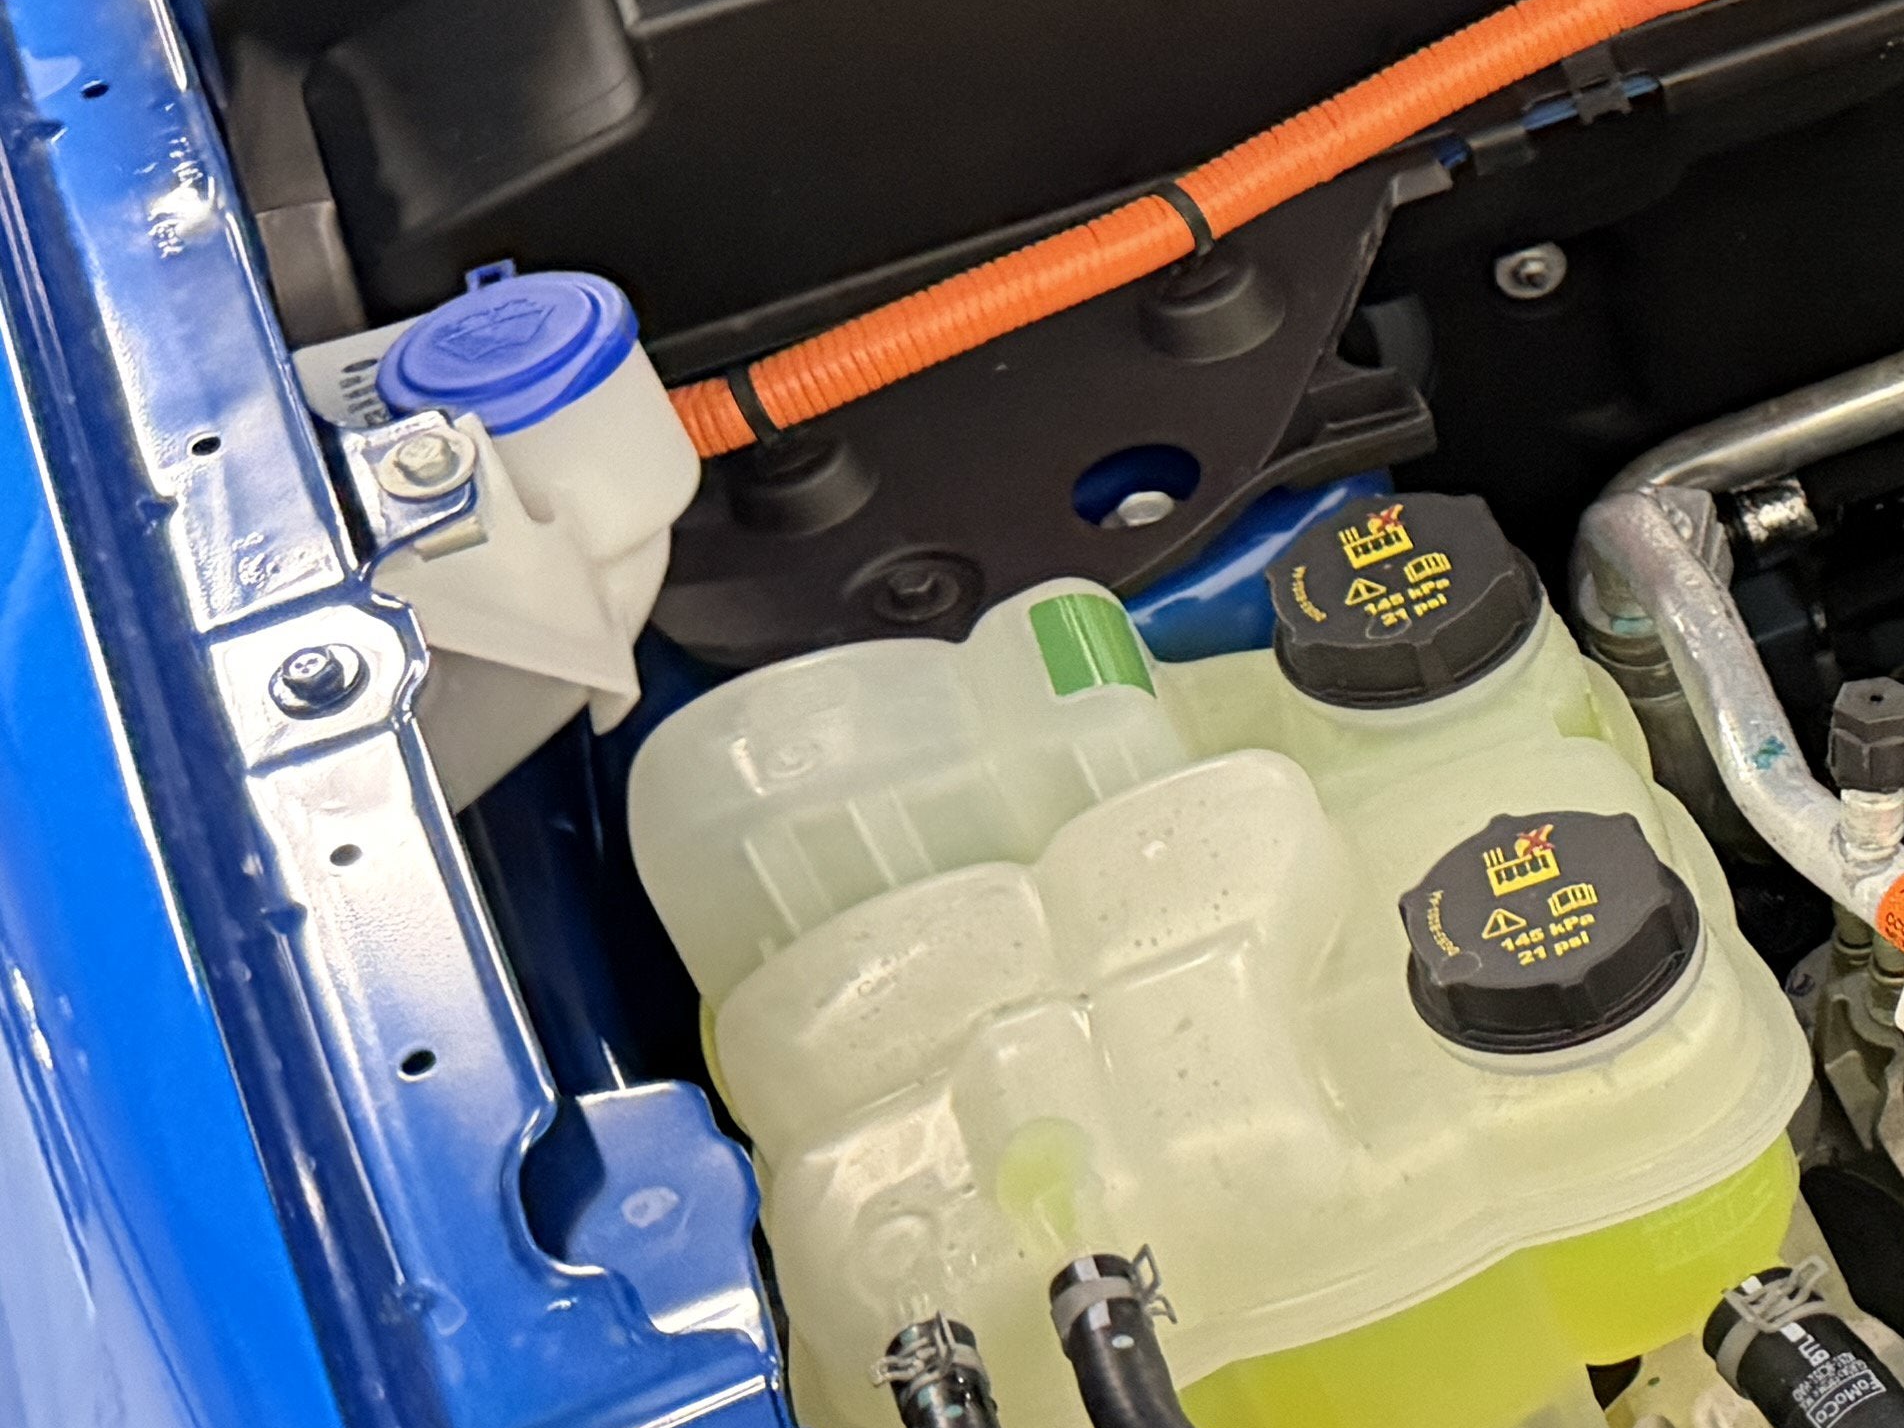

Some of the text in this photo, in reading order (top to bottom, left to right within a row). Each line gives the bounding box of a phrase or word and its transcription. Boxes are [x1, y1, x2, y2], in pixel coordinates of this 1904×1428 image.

[1364, 592, 1405, 616] 145
[1501, 913, 1595, 952] 145 kPa
[1518, 931, 1591, 965] 21 psi
[1798, 1333, 1831, 1368] BTL
[1815, 1373, 1883, 1424] FoMoCo
